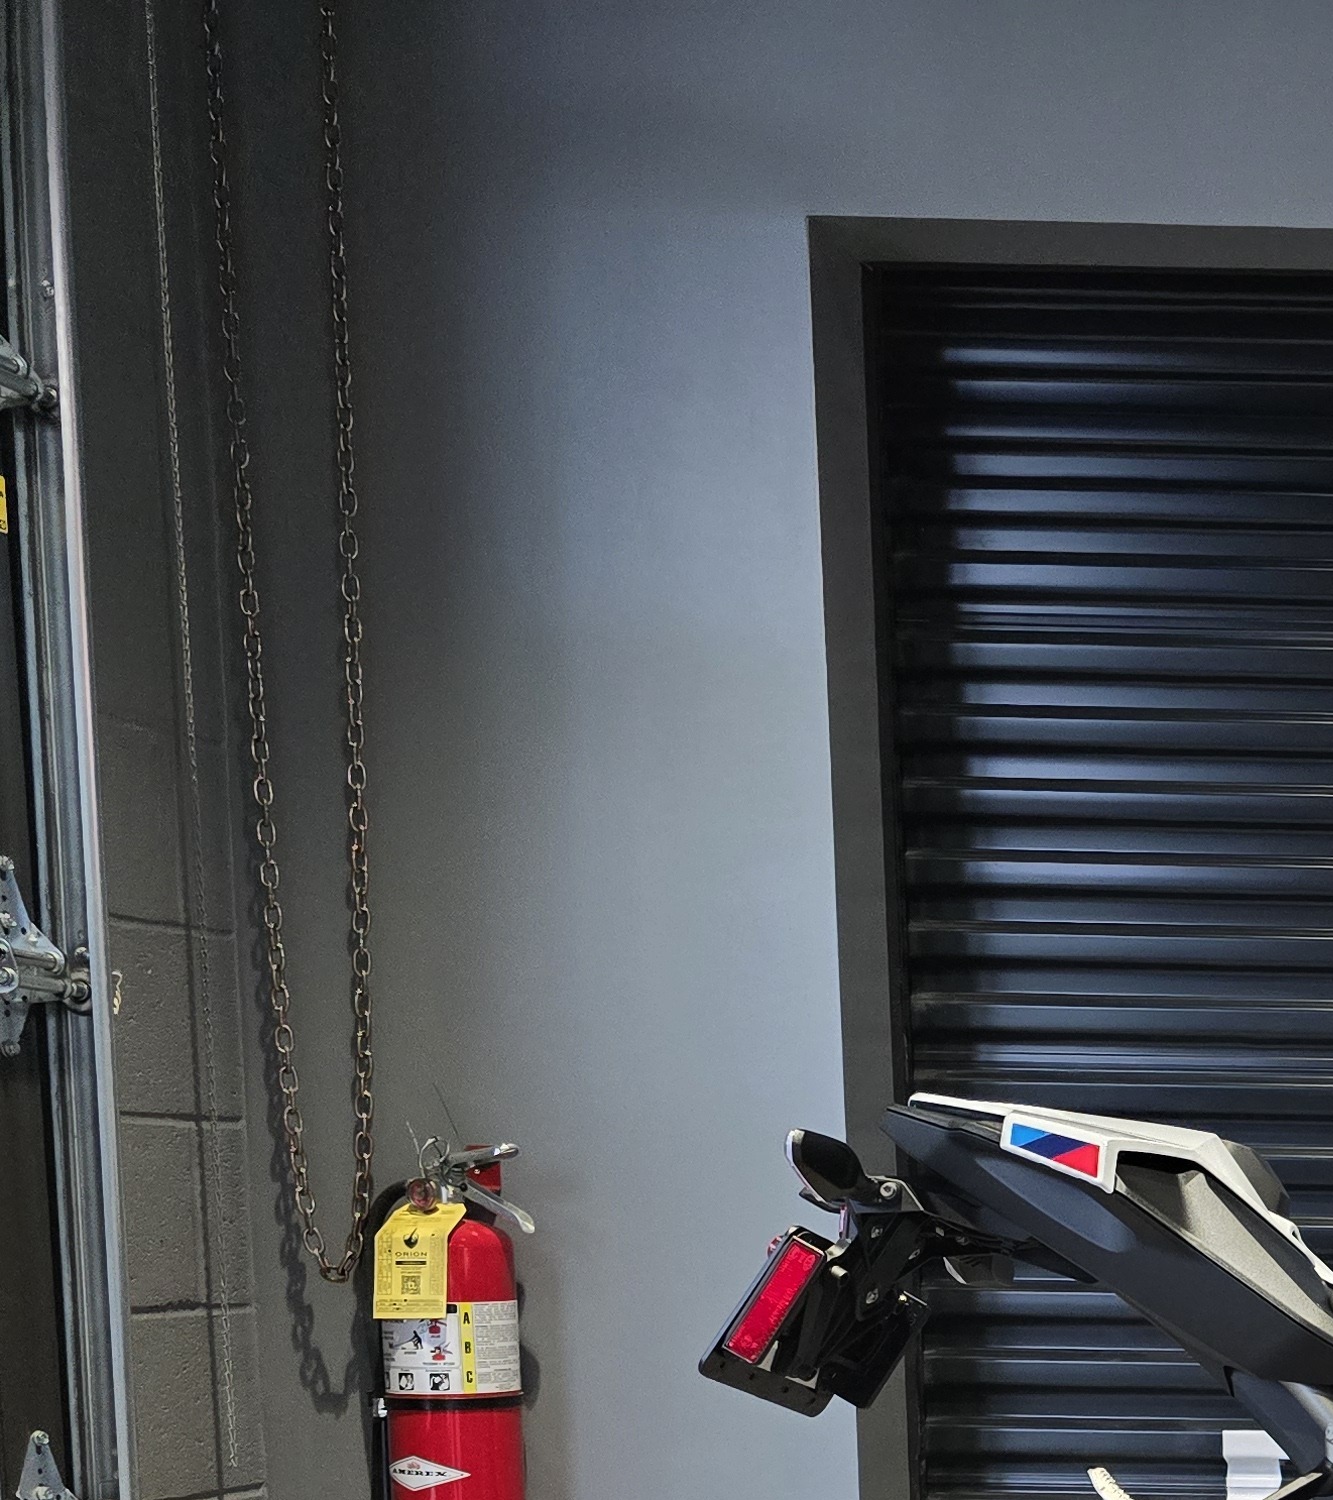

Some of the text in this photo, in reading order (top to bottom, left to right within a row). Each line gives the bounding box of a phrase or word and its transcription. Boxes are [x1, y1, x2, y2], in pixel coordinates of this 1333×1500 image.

[463, 1311, 471, 1325] A
[465, 1341, 472, 1354] B
[466, 1370, 473, 1383] C
